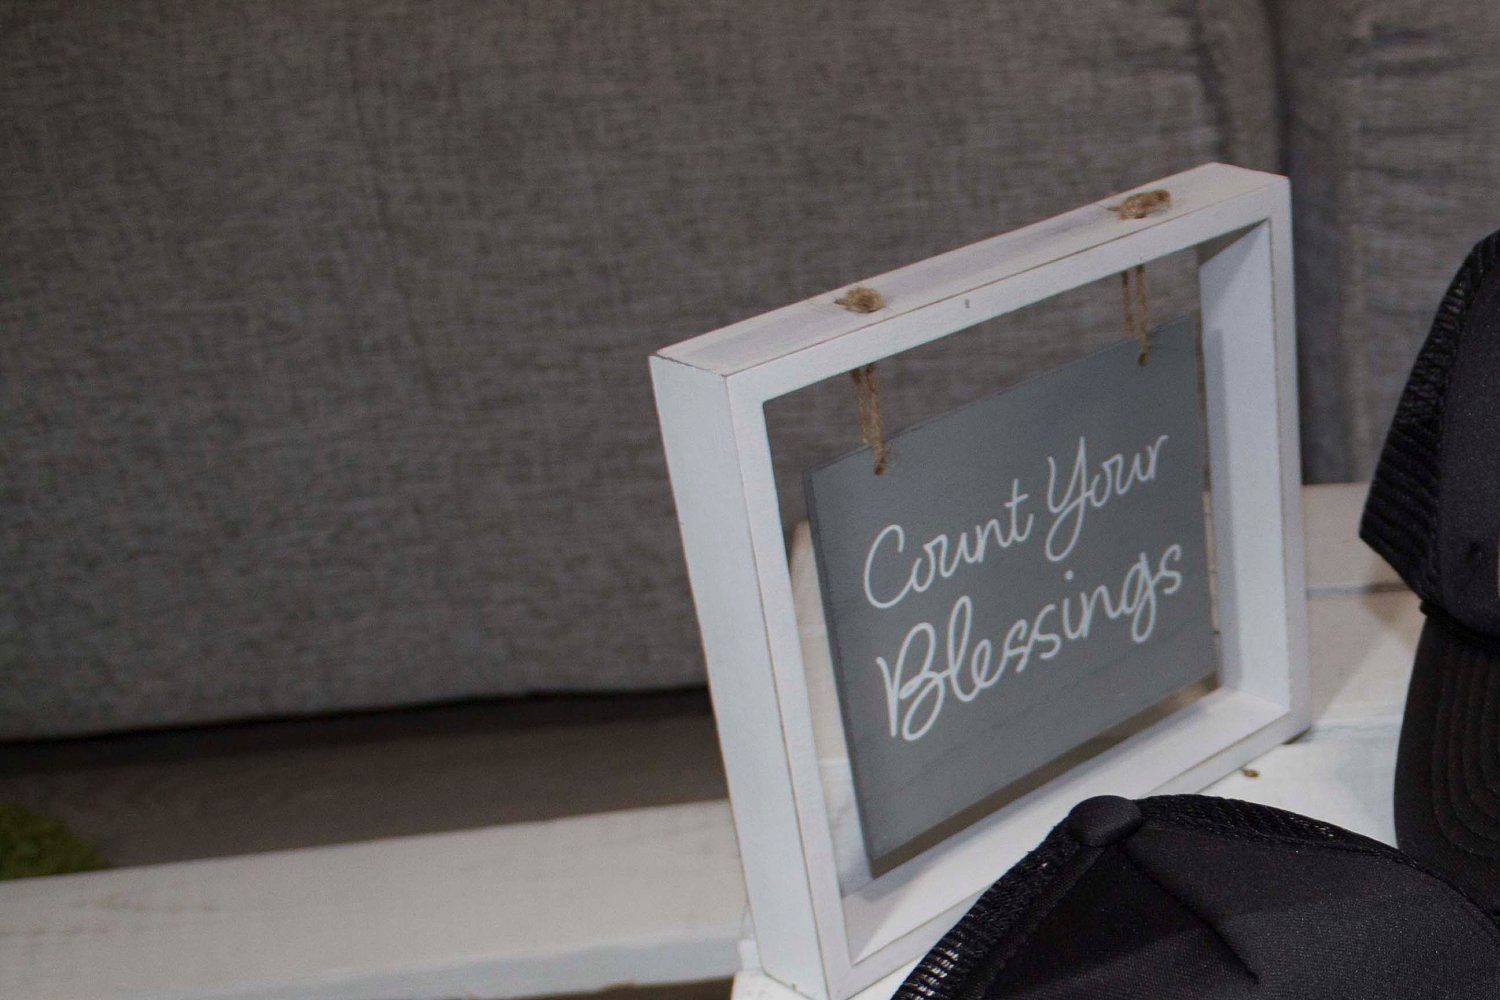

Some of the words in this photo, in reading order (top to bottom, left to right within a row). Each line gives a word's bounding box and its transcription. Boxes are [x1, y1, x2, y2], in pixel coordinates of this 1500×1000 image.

[864, 478, 1034, 609] Count
[1045, 435, 1169, 562] Your
[876, 543, 1183, 741] Blessings
